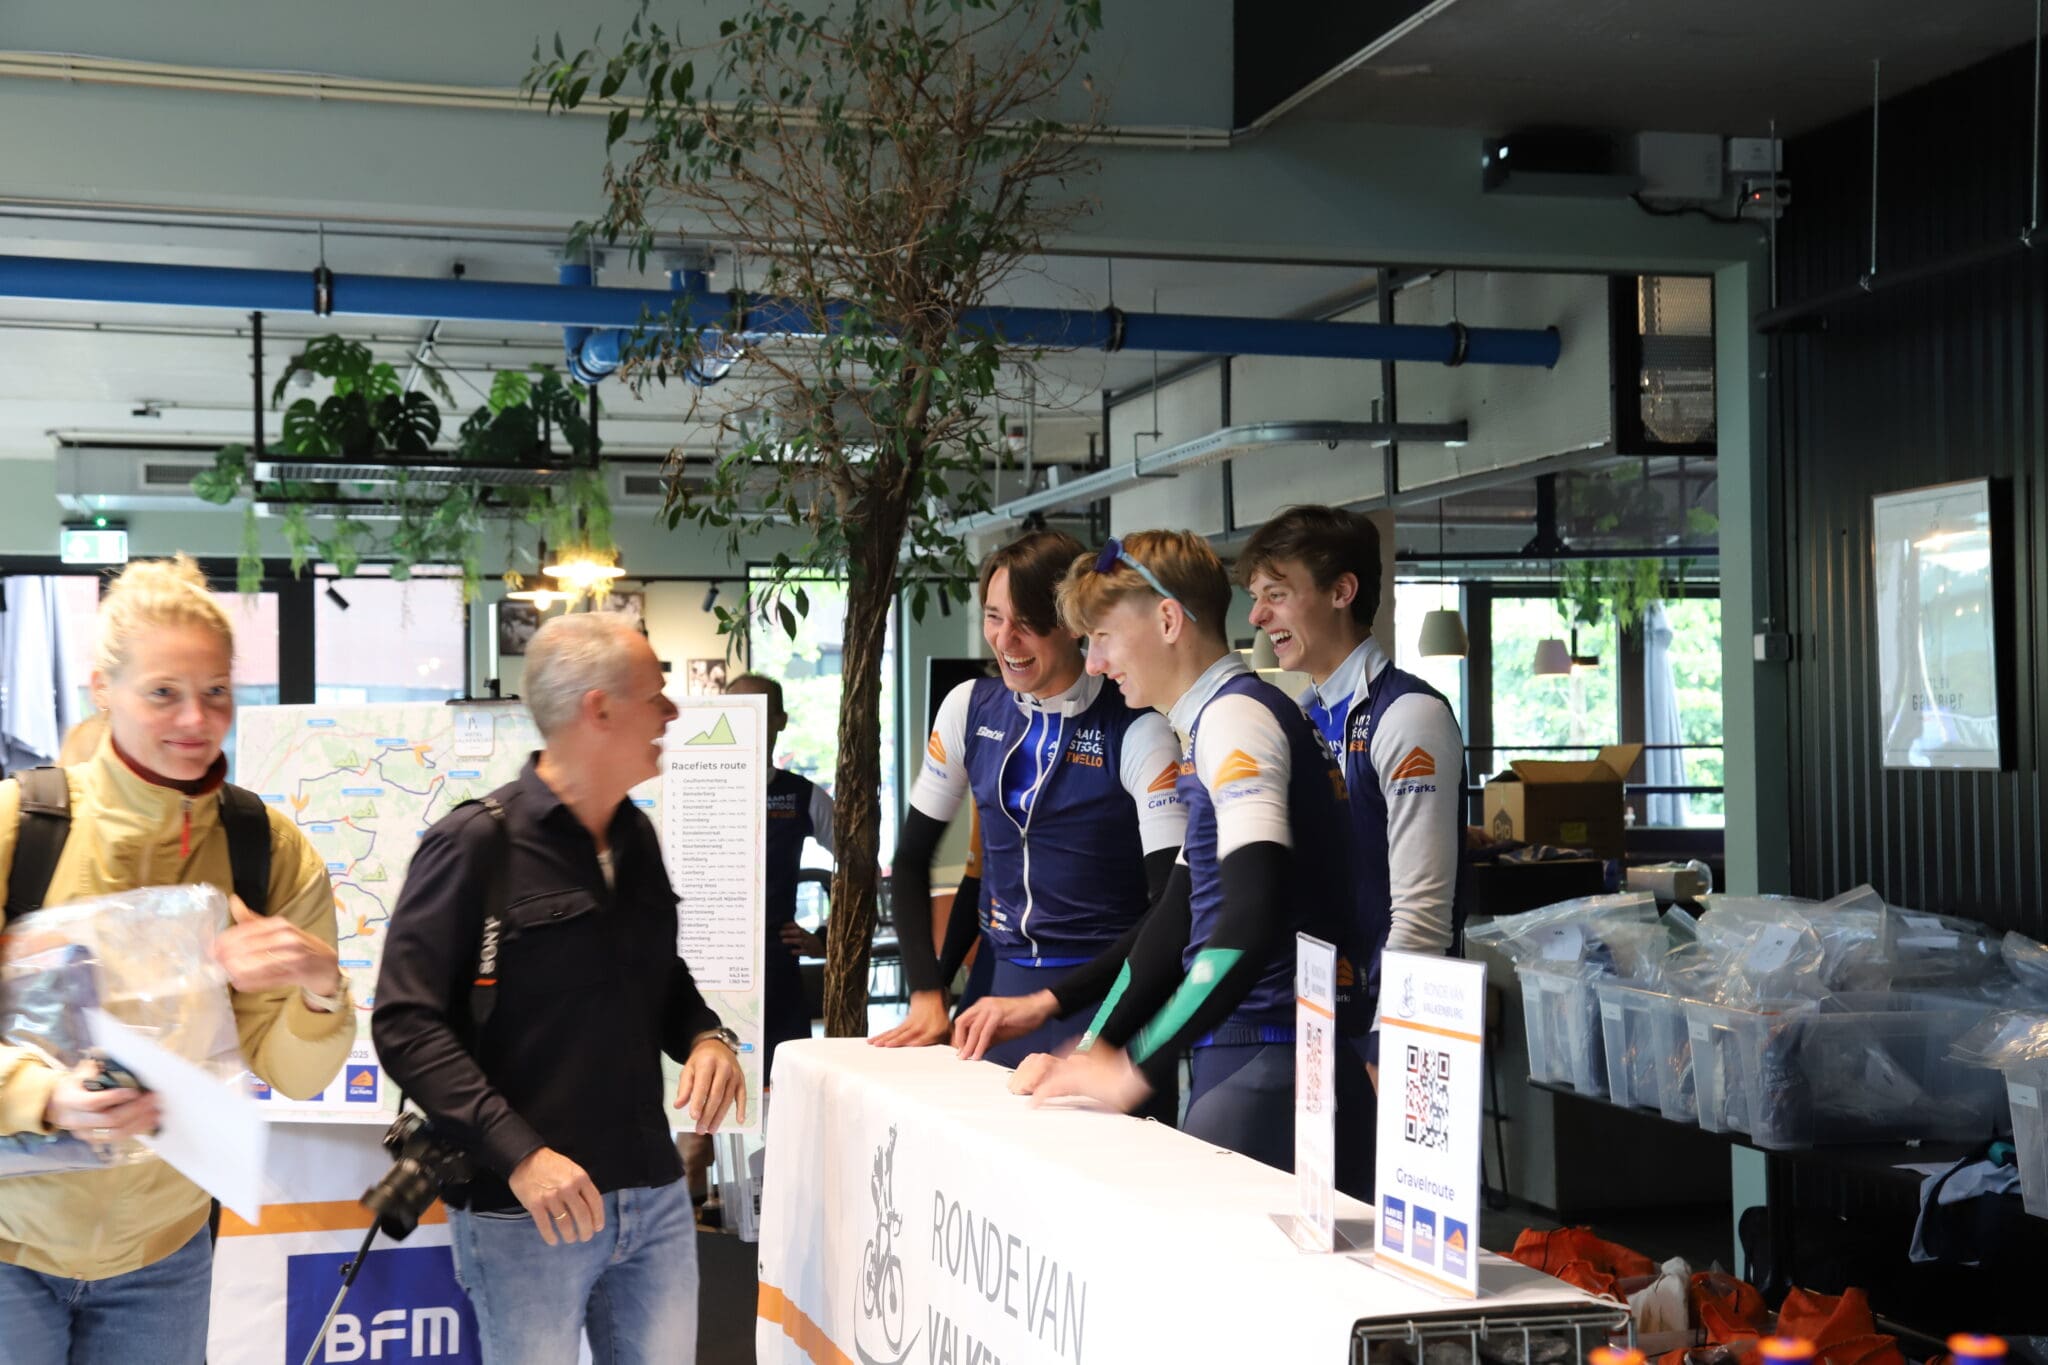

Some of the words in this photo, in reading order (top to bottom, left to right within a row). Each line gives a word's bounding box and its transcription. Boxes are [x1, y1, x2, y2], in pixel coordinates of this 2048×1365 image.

[672, 762, 717, 770] Racefiets
[720, 762, 747, 770] route
[1408, 784, 1436, 793] Parks
[1148, 800, 1166, 809] Car
[479, 915, 501, 975] SONY
[1396, 1167, 1456, 1201] Gravelroute
